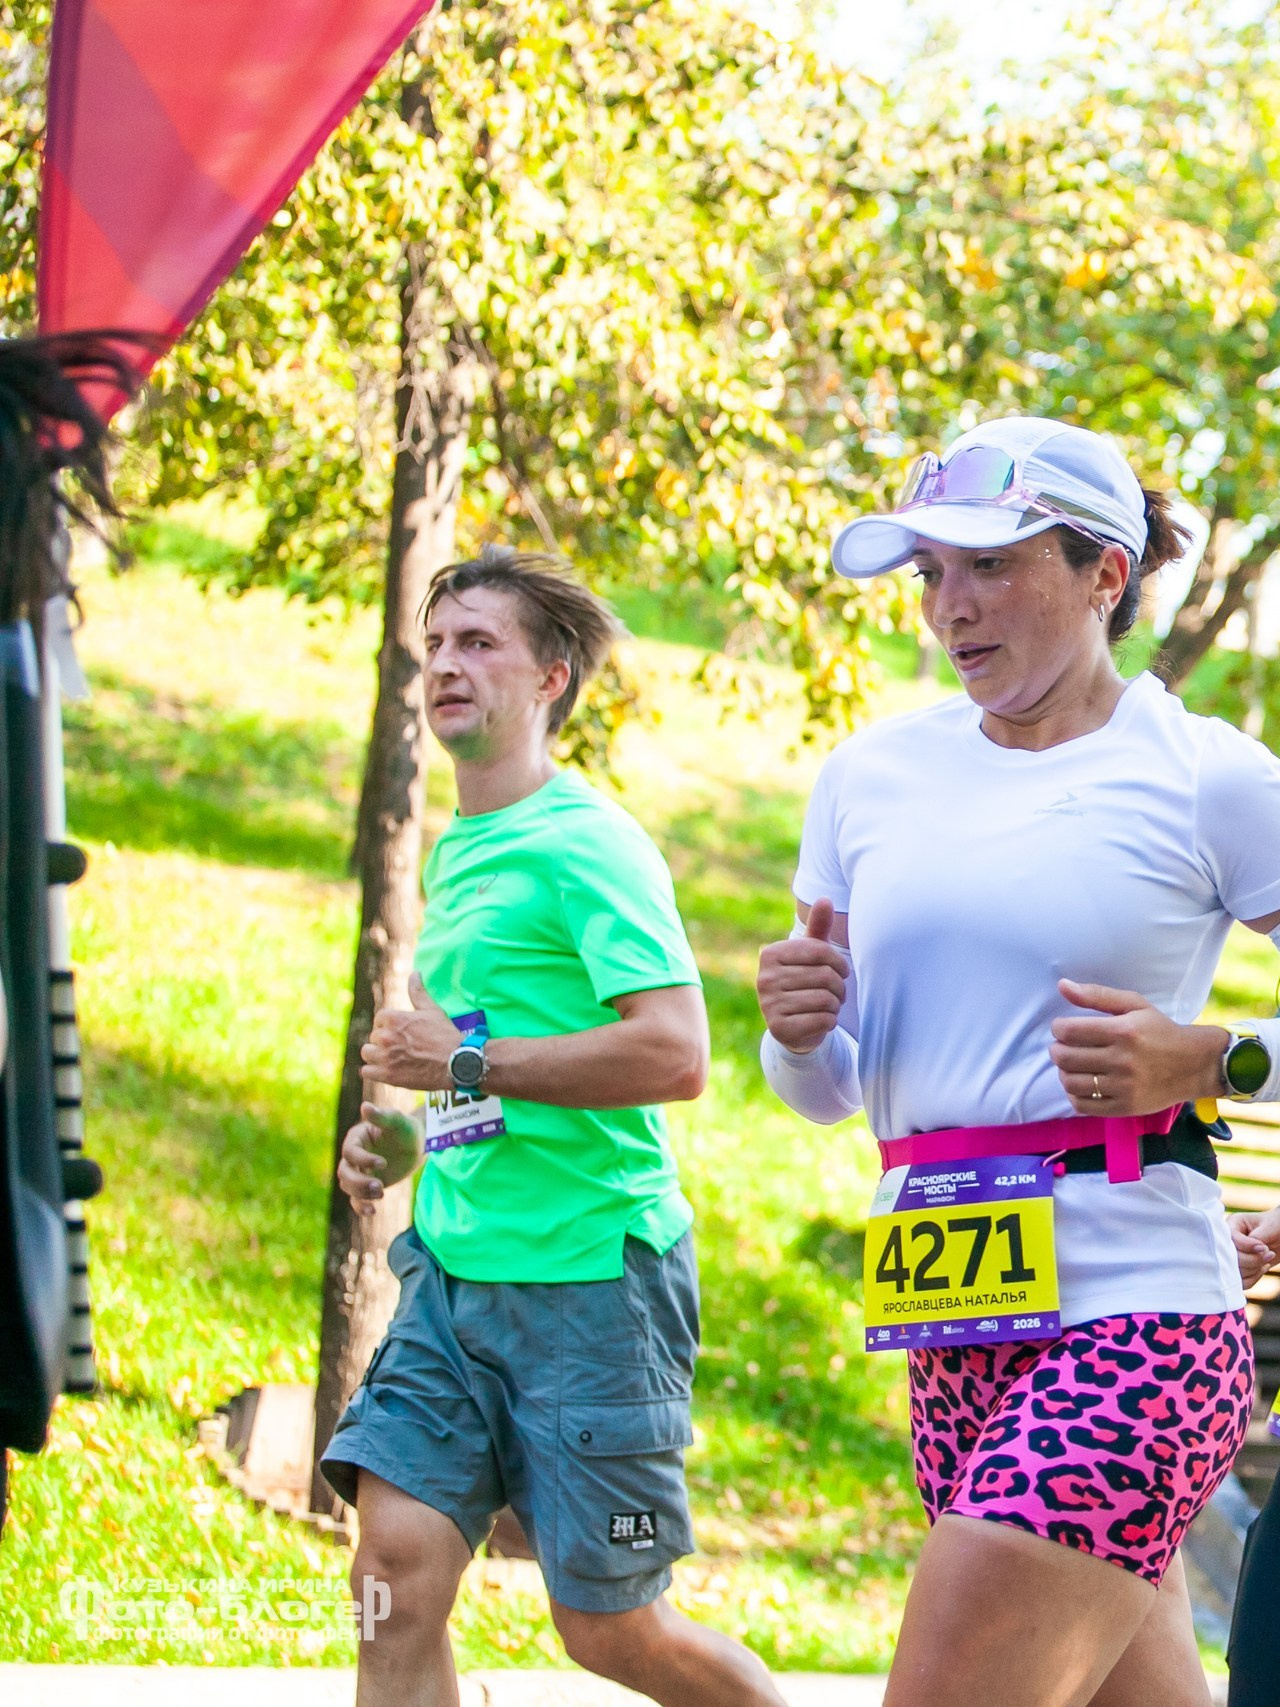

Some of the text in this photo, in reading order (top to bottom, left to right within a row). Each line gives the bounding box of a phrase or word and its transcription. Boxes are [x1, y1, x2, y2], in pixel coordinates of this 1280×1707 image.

[908, 1171, 977, 1188] КРАСНОЯРСКИЕ
[994, 1174, 1036, 1187] 42,2 КМ
[924, 1183, 957, 1196] МОСТЫ
[876, 1213, 1036, 1294] 4271
[883, 1291, 1027, 1314] ЯРОСЛАВЦЕВА НАТАЛЬЯ
[1013, 1318, 1041, 1329] 2026
